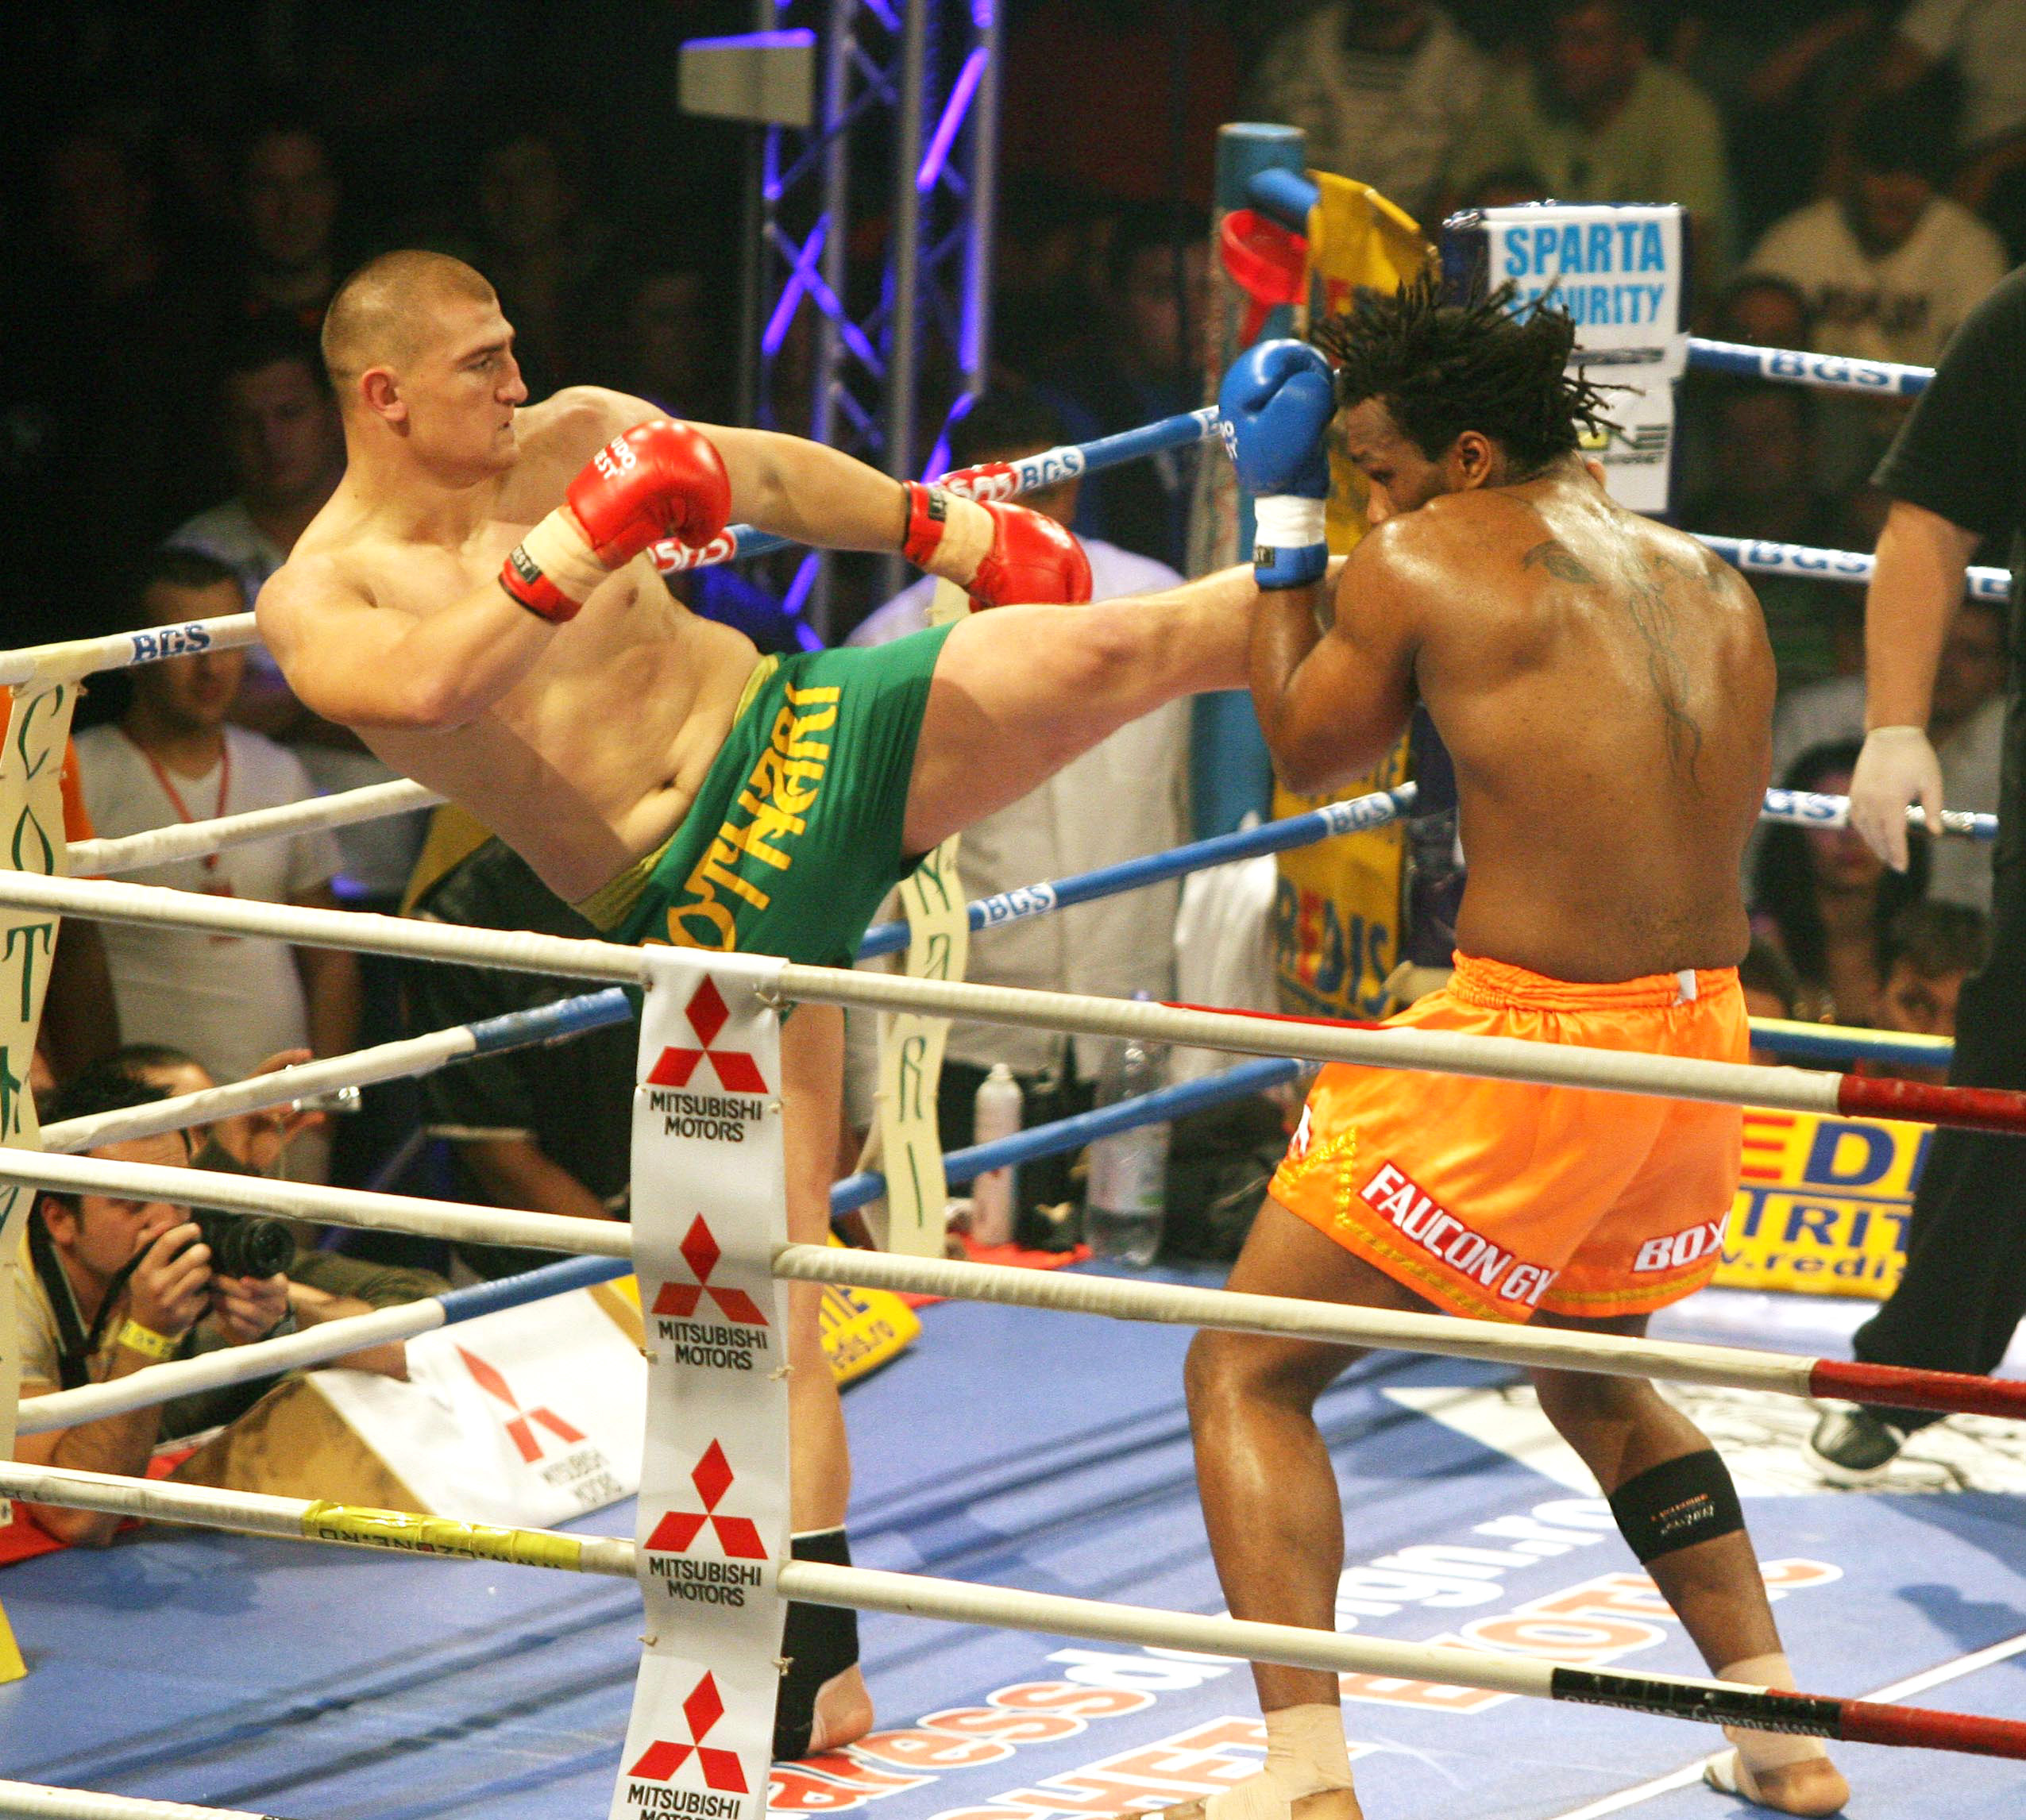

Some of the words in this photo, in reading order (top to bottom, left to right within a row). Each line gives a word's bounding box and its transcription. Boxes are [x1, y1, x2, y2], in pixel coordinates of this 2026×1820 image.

[1504, 221, 1665, 276] SPARTA
[1769, 352, 1889, 386] BGS
[1022, 453, 1078, 492] BGS
[131, 624, 210, 664] BGS
[639, 681, 841, 952] OTNARI
[987, 885, 1052, 922] BGS
[650, 1090, 762, 1121] MITSUBISHI
[665, 1116, 744, 1143] MOTORS
[1360, 1163, 1513, 1286] FAUCON
[658, 1321, 768, 1350] MITSUBISHI
[675, 1344, 753, 1371] MOTORS
[649, 1556, 762, 1587] MITSUBISHI
[667, 1579, 745, 1607] MOTORS
[627, 1783, 740, 1820] MITSUBISHI
